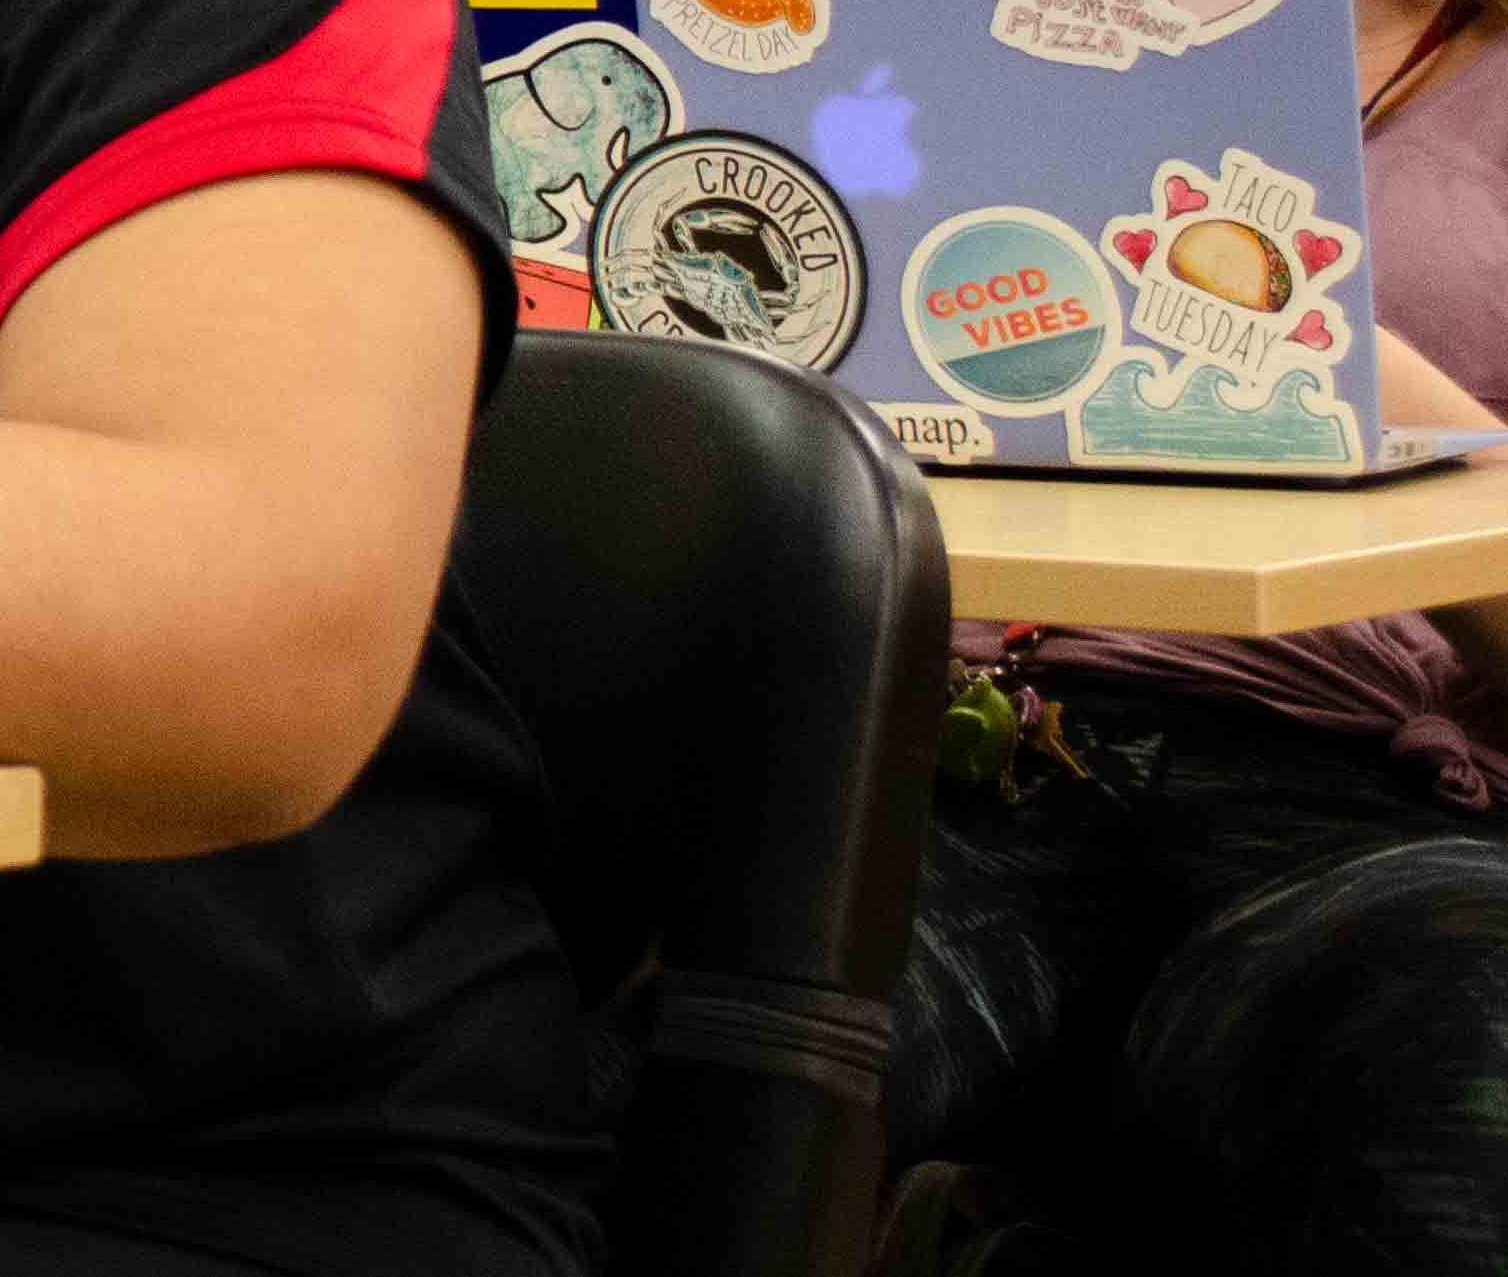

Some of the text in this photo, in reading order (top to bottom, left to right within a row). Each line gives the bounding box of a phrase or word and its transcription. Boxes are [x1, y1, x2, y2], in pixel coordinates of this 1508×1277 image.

[756, 26, 800, 61] DAY
[695, 156, 839, 272] CROOKED
[1223, 163, 1297, 233] TACO
[926, 267, 1050, 320] GOOD
[961, 296, 1090, 349] VIBES
[1141, 279, 1280, 373] TUESDAY
[895, 415, 980, 455] nap.
